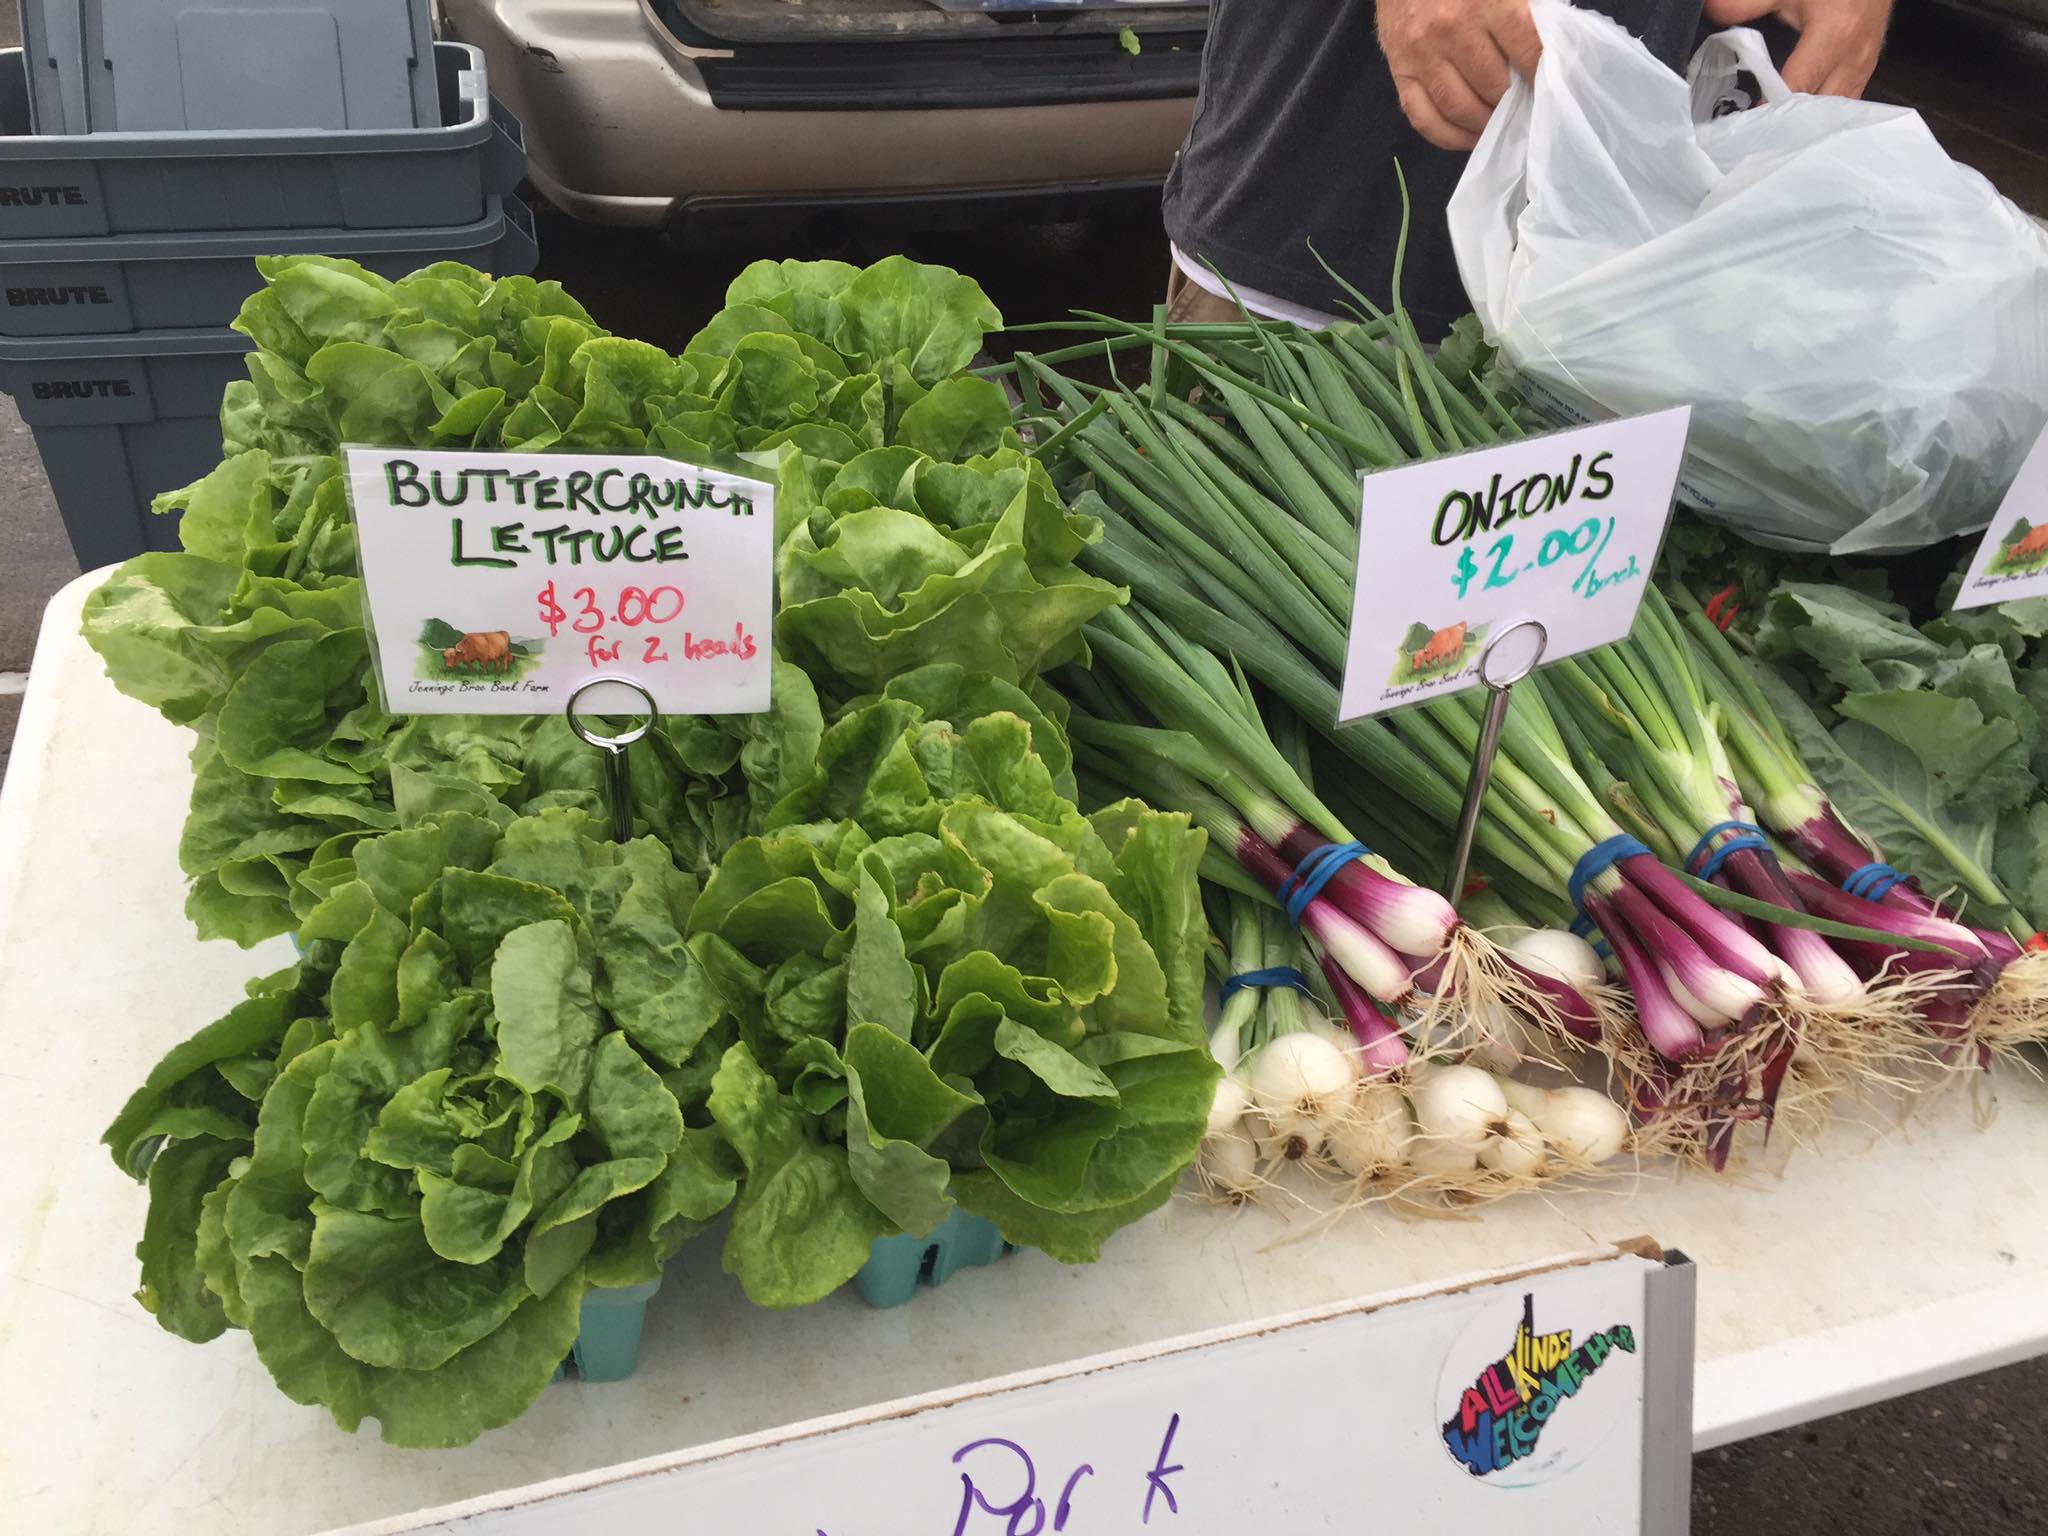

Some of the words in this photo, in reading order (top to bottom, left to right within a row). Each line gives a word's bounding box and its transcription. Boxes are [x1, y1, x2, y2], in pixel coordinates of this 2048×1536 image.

[384, 459, 755, 518] BUTTERCRUNCH
[1431, 451, 1614, 546] ONIONS
[451, 518, 689, 568] LETTUCE
[537, 579, 686, 638] $3.00
[584, 635, 622, 668] for
[642, 636, 668, 663] 2
[685, 622, 758, 662] heads
[1443, 1353, 1590, 1476] WELCOME
[1460, 1364, 1522, 1433] ALL
